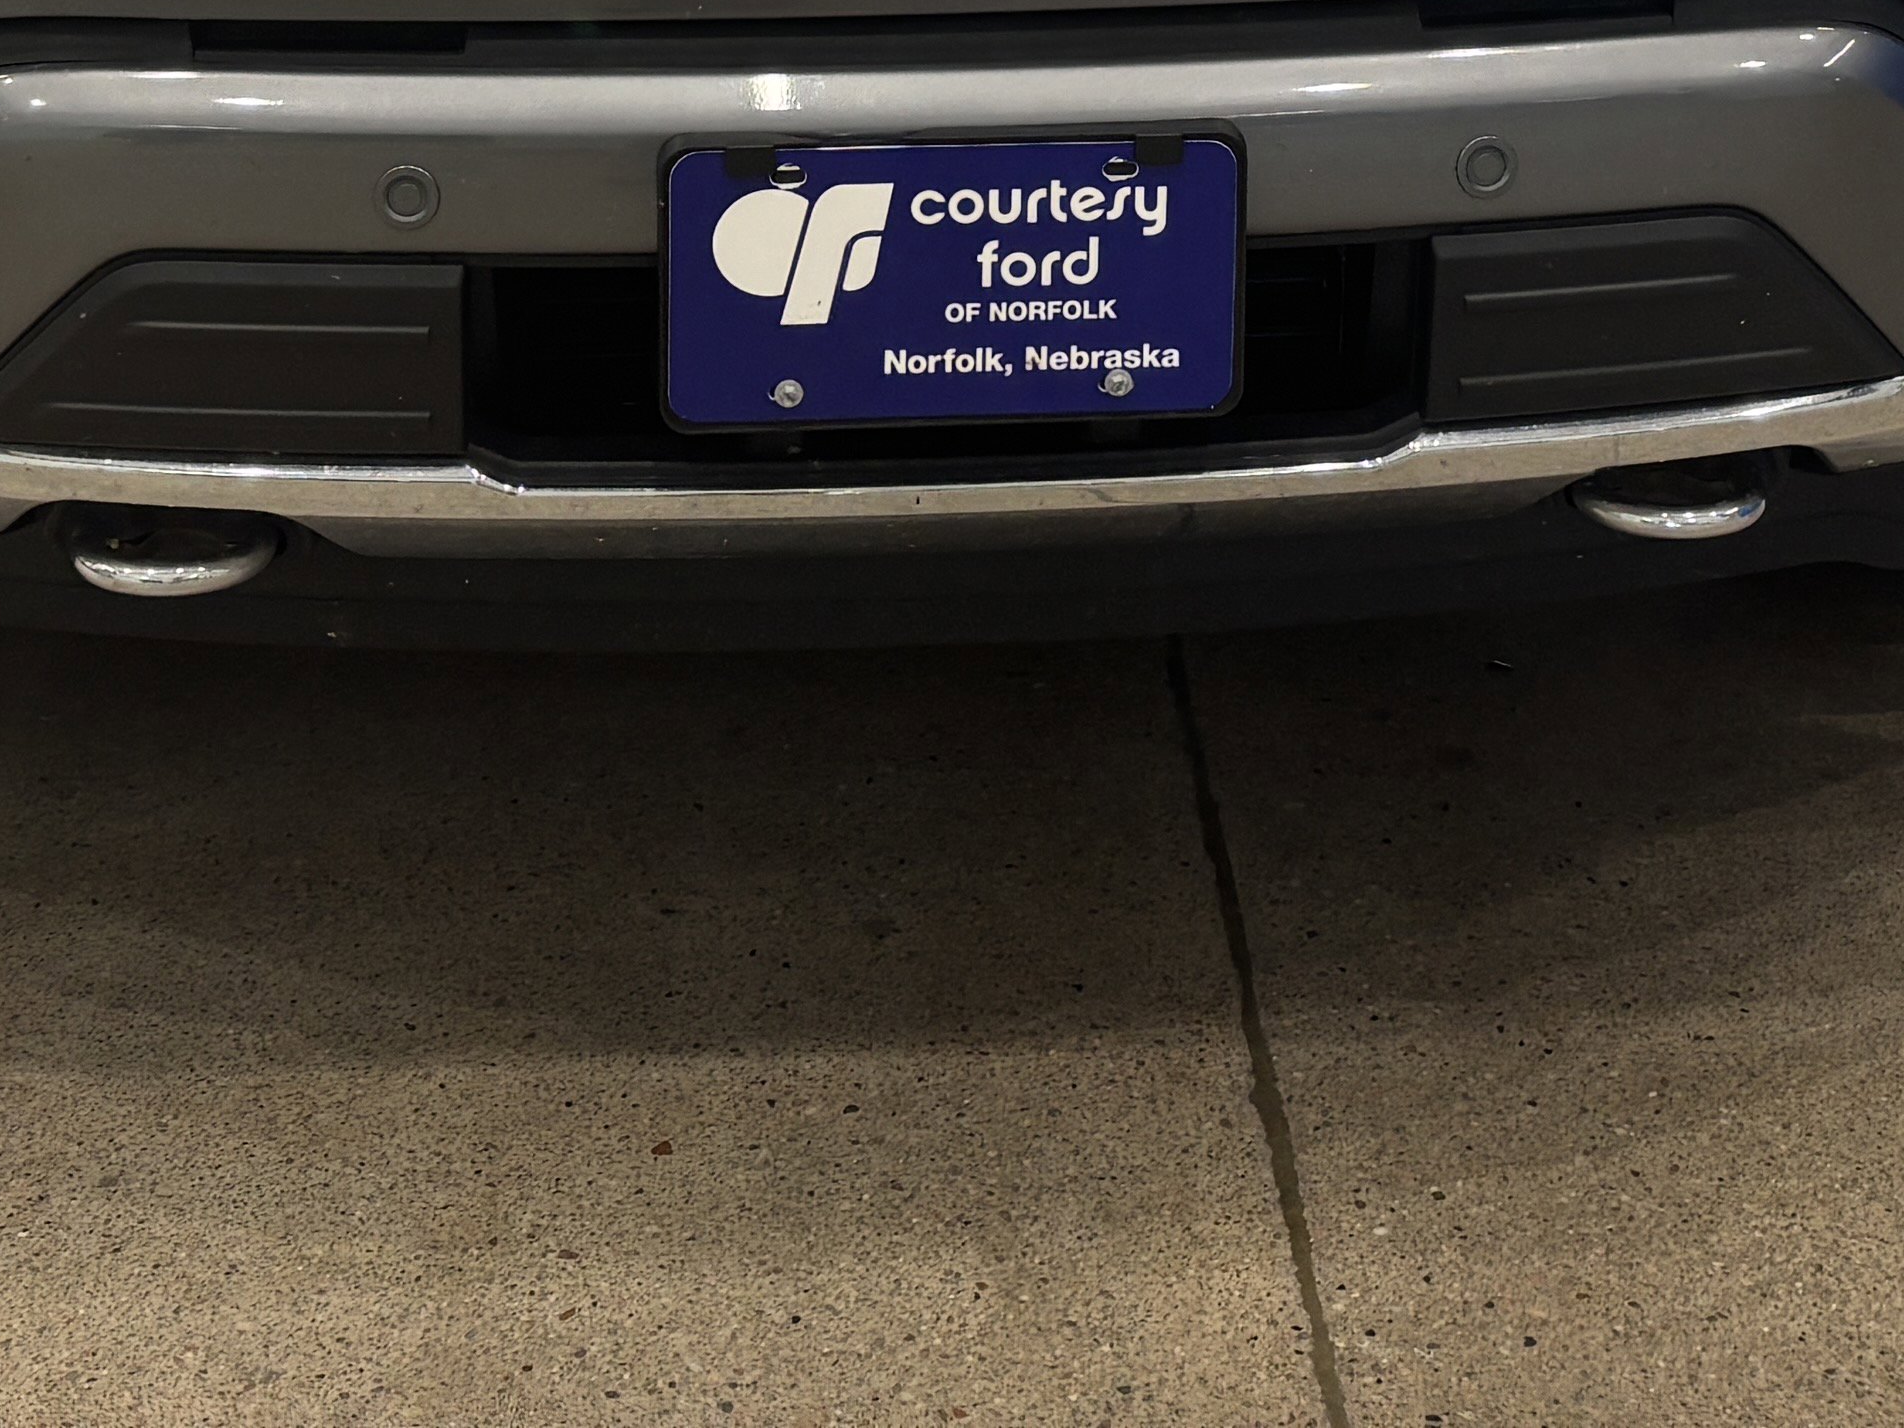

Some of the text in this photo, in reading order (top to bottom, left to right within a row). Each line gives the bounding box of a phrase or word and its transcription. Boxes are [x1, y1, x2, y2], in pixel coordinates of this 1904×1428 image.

[910, 179, 1168, 236] courtesy
[976, 236, 1100, 288] ford
[945, 299, 1118, 323] OF NORFOLK
[884, 343, 1180, 377] Norfolk, Nebraska
